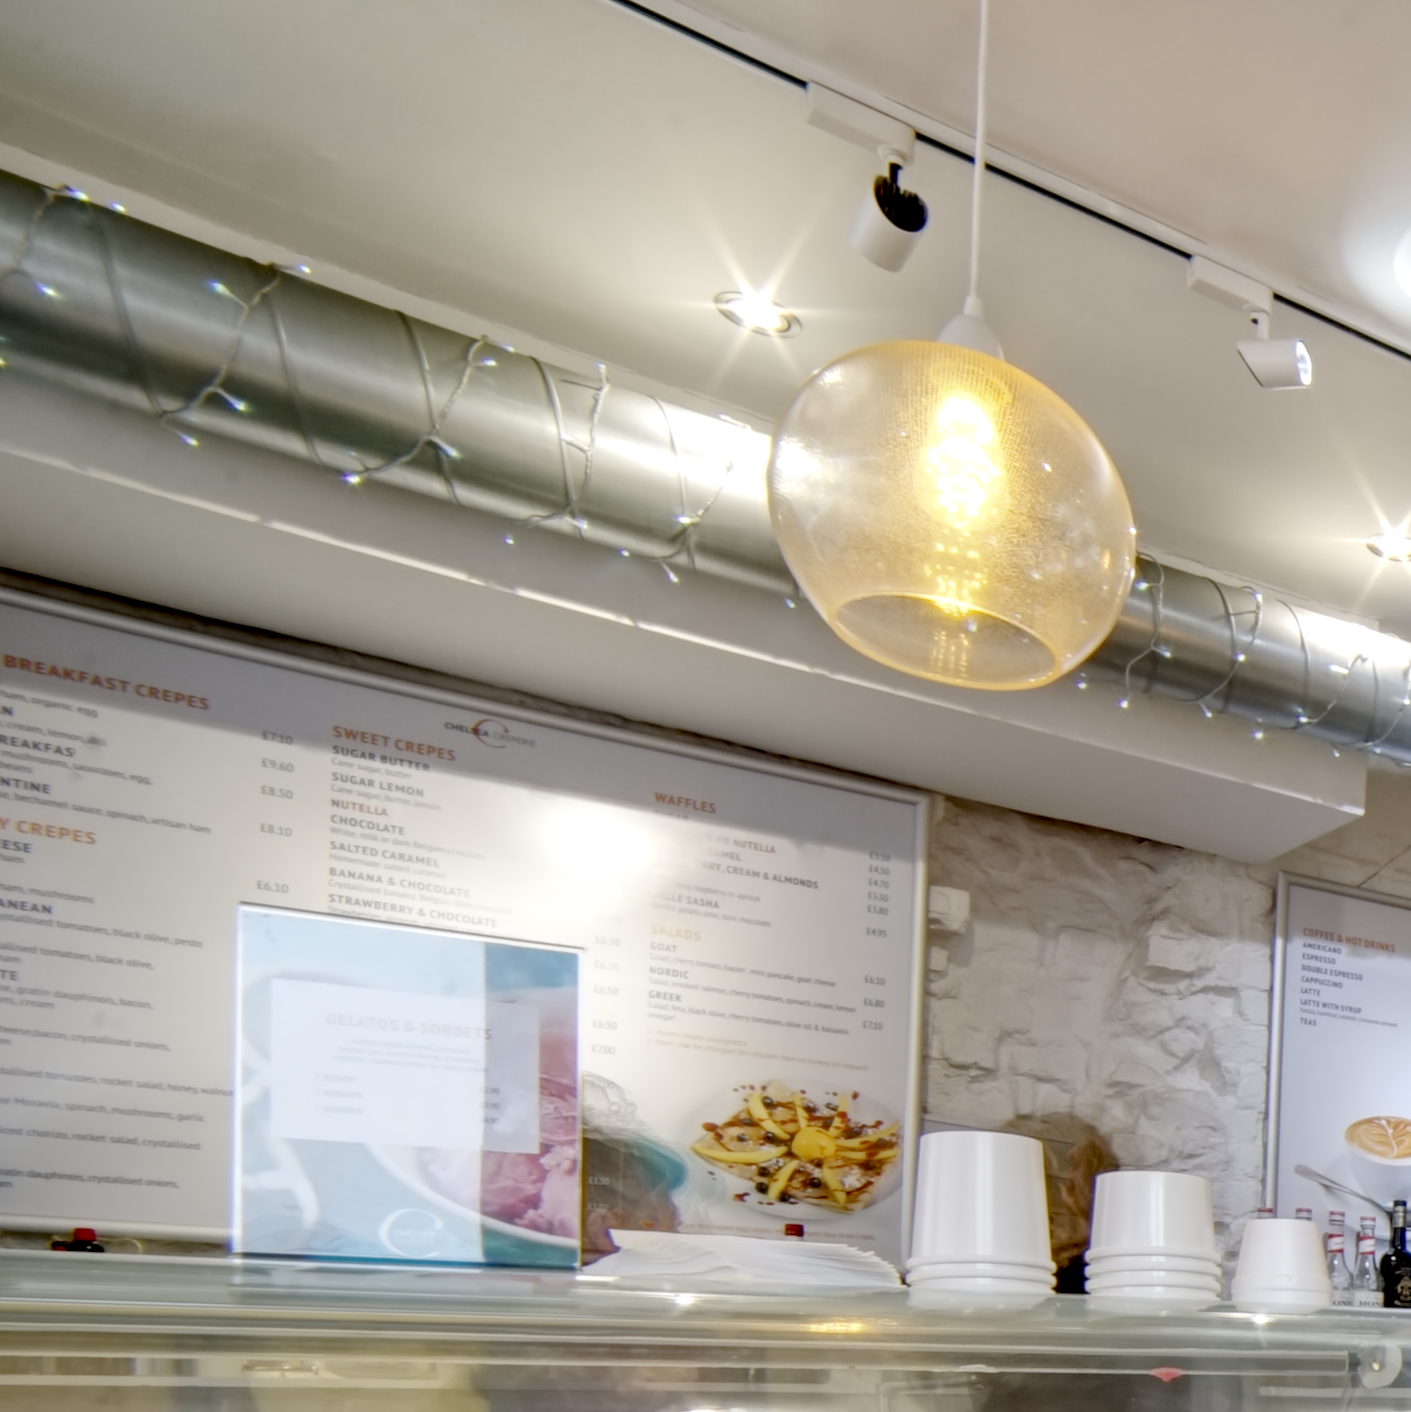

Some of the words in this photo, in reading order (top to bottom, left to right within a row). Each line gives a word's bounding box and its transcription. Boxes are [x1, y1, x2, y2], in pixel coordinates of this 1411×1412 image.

[2, 654, 130, 693] BREAKFAST
[134, 683, 210, 710] CREPES
[444, 722, 489, 737] CHELSEA
[262, 731, 293, 746] £7.10
[332, 725, 391, 748] SWEET
[395, 738, 456, 761] CREPES
[261, 758, 294, 773] £9.60
[332, 745, 376, 763] SUGAR
[380, 754, 430, 772] BUTTER
[261, 785, 293, 800] £8.50
[332, 772, 376, 789] SUGAR
[379, 780, 424, 797] LEMON
[331, 798, 389, 817] NUTELLA
[654, 792, 716, 814] WAFFLES
[15, 820, 97, 845] CREPES
[260, 822, 292, 837] £8.10
[330, 814, 405, 836] CHOCOLATE
[733, 838, 776, 854] NUTELLA
[330, 841, 378, 858] SALTED
[382, 849, 440, 869] CARAMEL
[256, 880, 289, 895] £6.10
[329, 867, 383, 885] BANANA
[387, 876, 396, 886] &
[399, 879, 471, 899] CHOCOLATE
[763, 872, 770, 880] &
[772, 873, 819, 890] ALMONDS
[328, 893, 414, 915] STRAWBERRY
[417, 908, 426, 918] &
[429, 909, 498, 929] CHOCOLATE
[686, 896, 720, 910] SASHA
[650, 923, 702, 942] SALADS
[1303, 927, 1334, 940] COFFEE
[1337, 934, 1344, 943] &
[1345, 935, 1362, 946] HOT
[1364, 939, 1395, 953] DRINKS
[650, 941, 677, 954] GOAT
[1303, 942, 1342, 955] AMERICANO
[1302, 953, 1336, 965] ESPRESSO
[649, 966, 690, 980] NORDIC
[1302, 964, 1328, 976] DOUBLE
[1330, 969, 1363, 981] ESPRESSO
[1301, 976, 1343, 989] CAPPUCCINO
[649, 989, 683, 1003] GREEK
[1300, 987, 1320, 997] LATTE
[1300, 998, 1320, 1008] LATTE
[1321, 1001, 1339, 1011] WITH
[1340, 1005, 1362, 1014] SYRUP
[325, 1013, 399, 1032] GELATOS
[404, 1020, 415, 1033] &
[420, 1022, 493, 1041] SORBETS
[1300, 1017, 1317, 1027] TEAS
